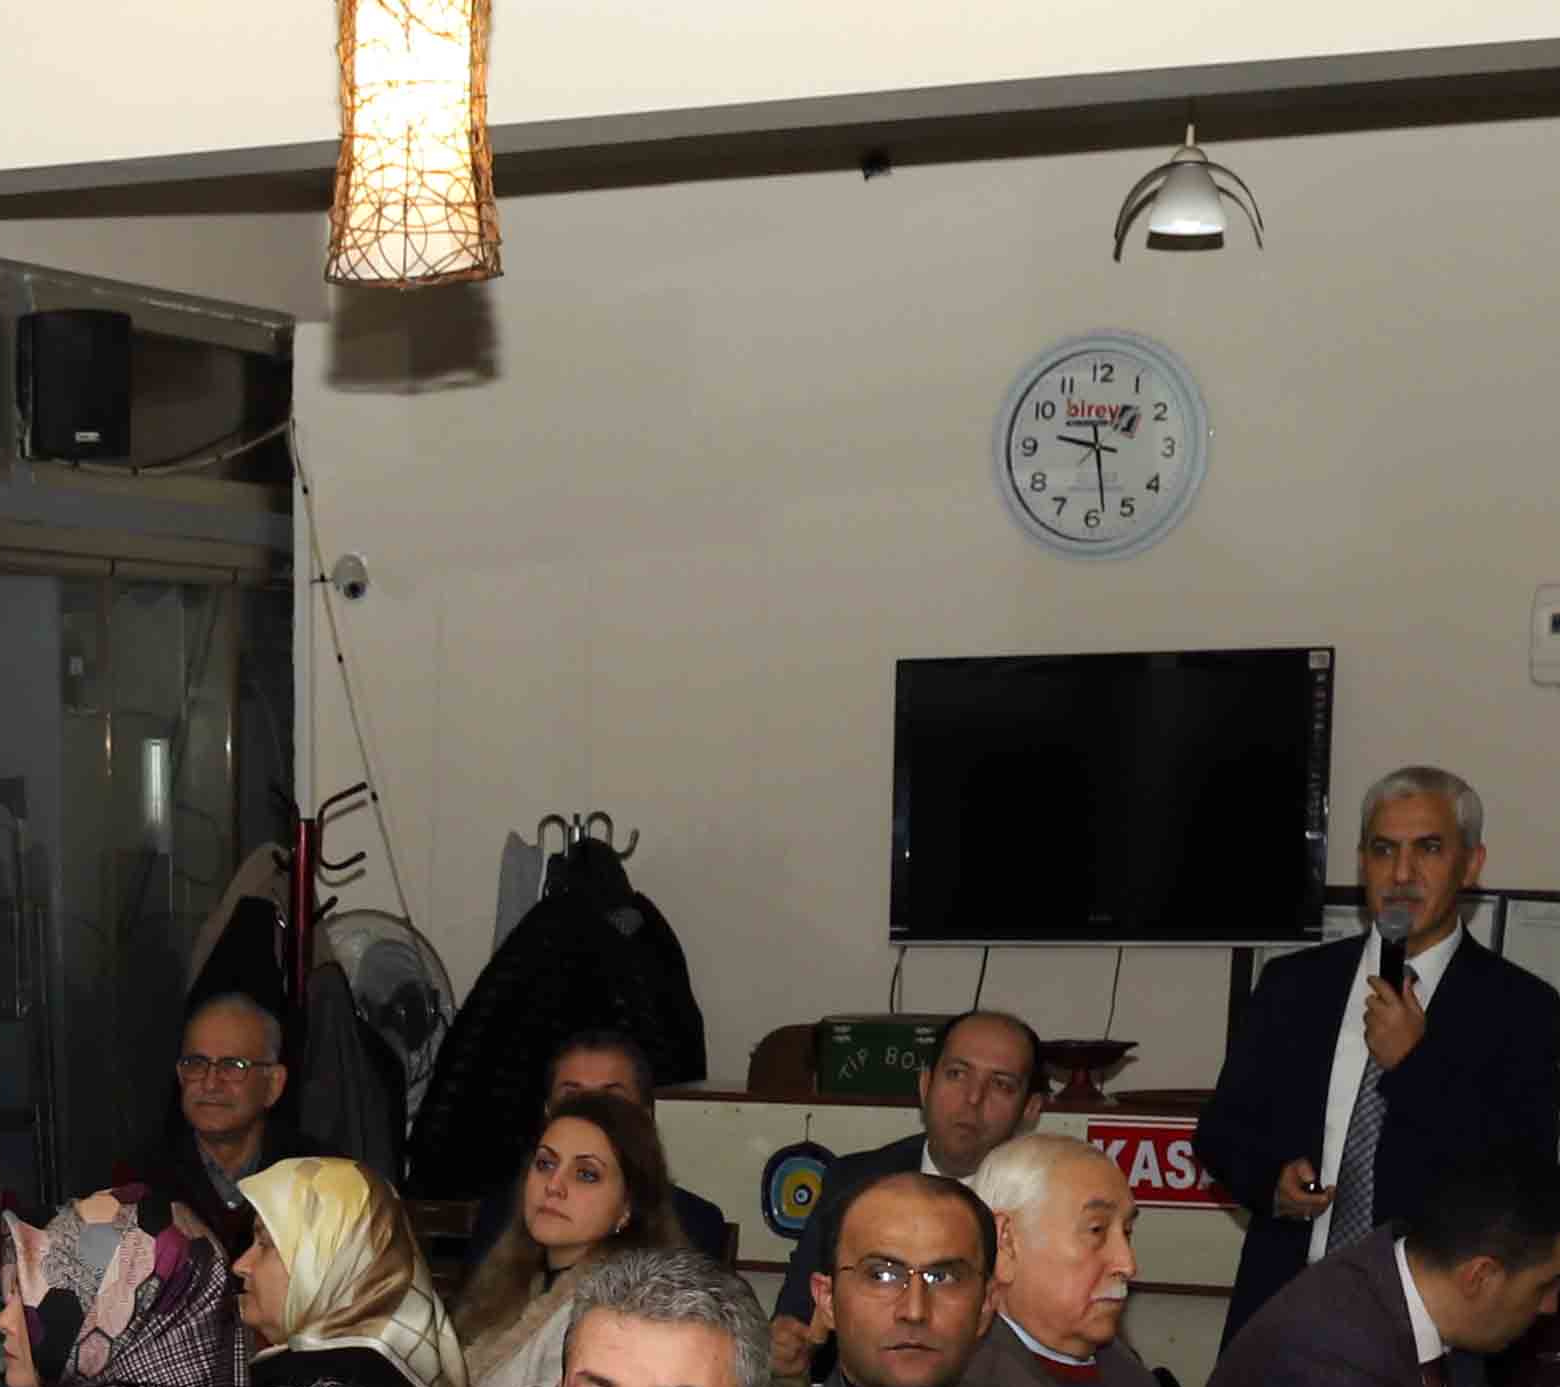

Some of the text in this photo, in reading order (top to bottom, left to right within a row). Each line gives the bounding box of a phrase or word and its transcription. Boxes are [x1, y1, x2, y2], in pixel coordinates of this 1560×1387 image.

[1092, 363, 1114, 383] 12
[1061, 375, 1074, 395] 11
[1134, 375, 1141, 395] 1
[1034, 401, 1056, 421] 10
[1152, 402, 1168, 422] 2
[1021, 437, 1038, 457] 9
[1161, 436, 1177, 458] 3
[1030, 472, 1047, 492] 8
[1145, 473, 1160, 493] 4
[1052, 496, 1067, 516] 7
[1119, 497, 1135, 517] 5
[1083, 509, 1101, 528] 6
